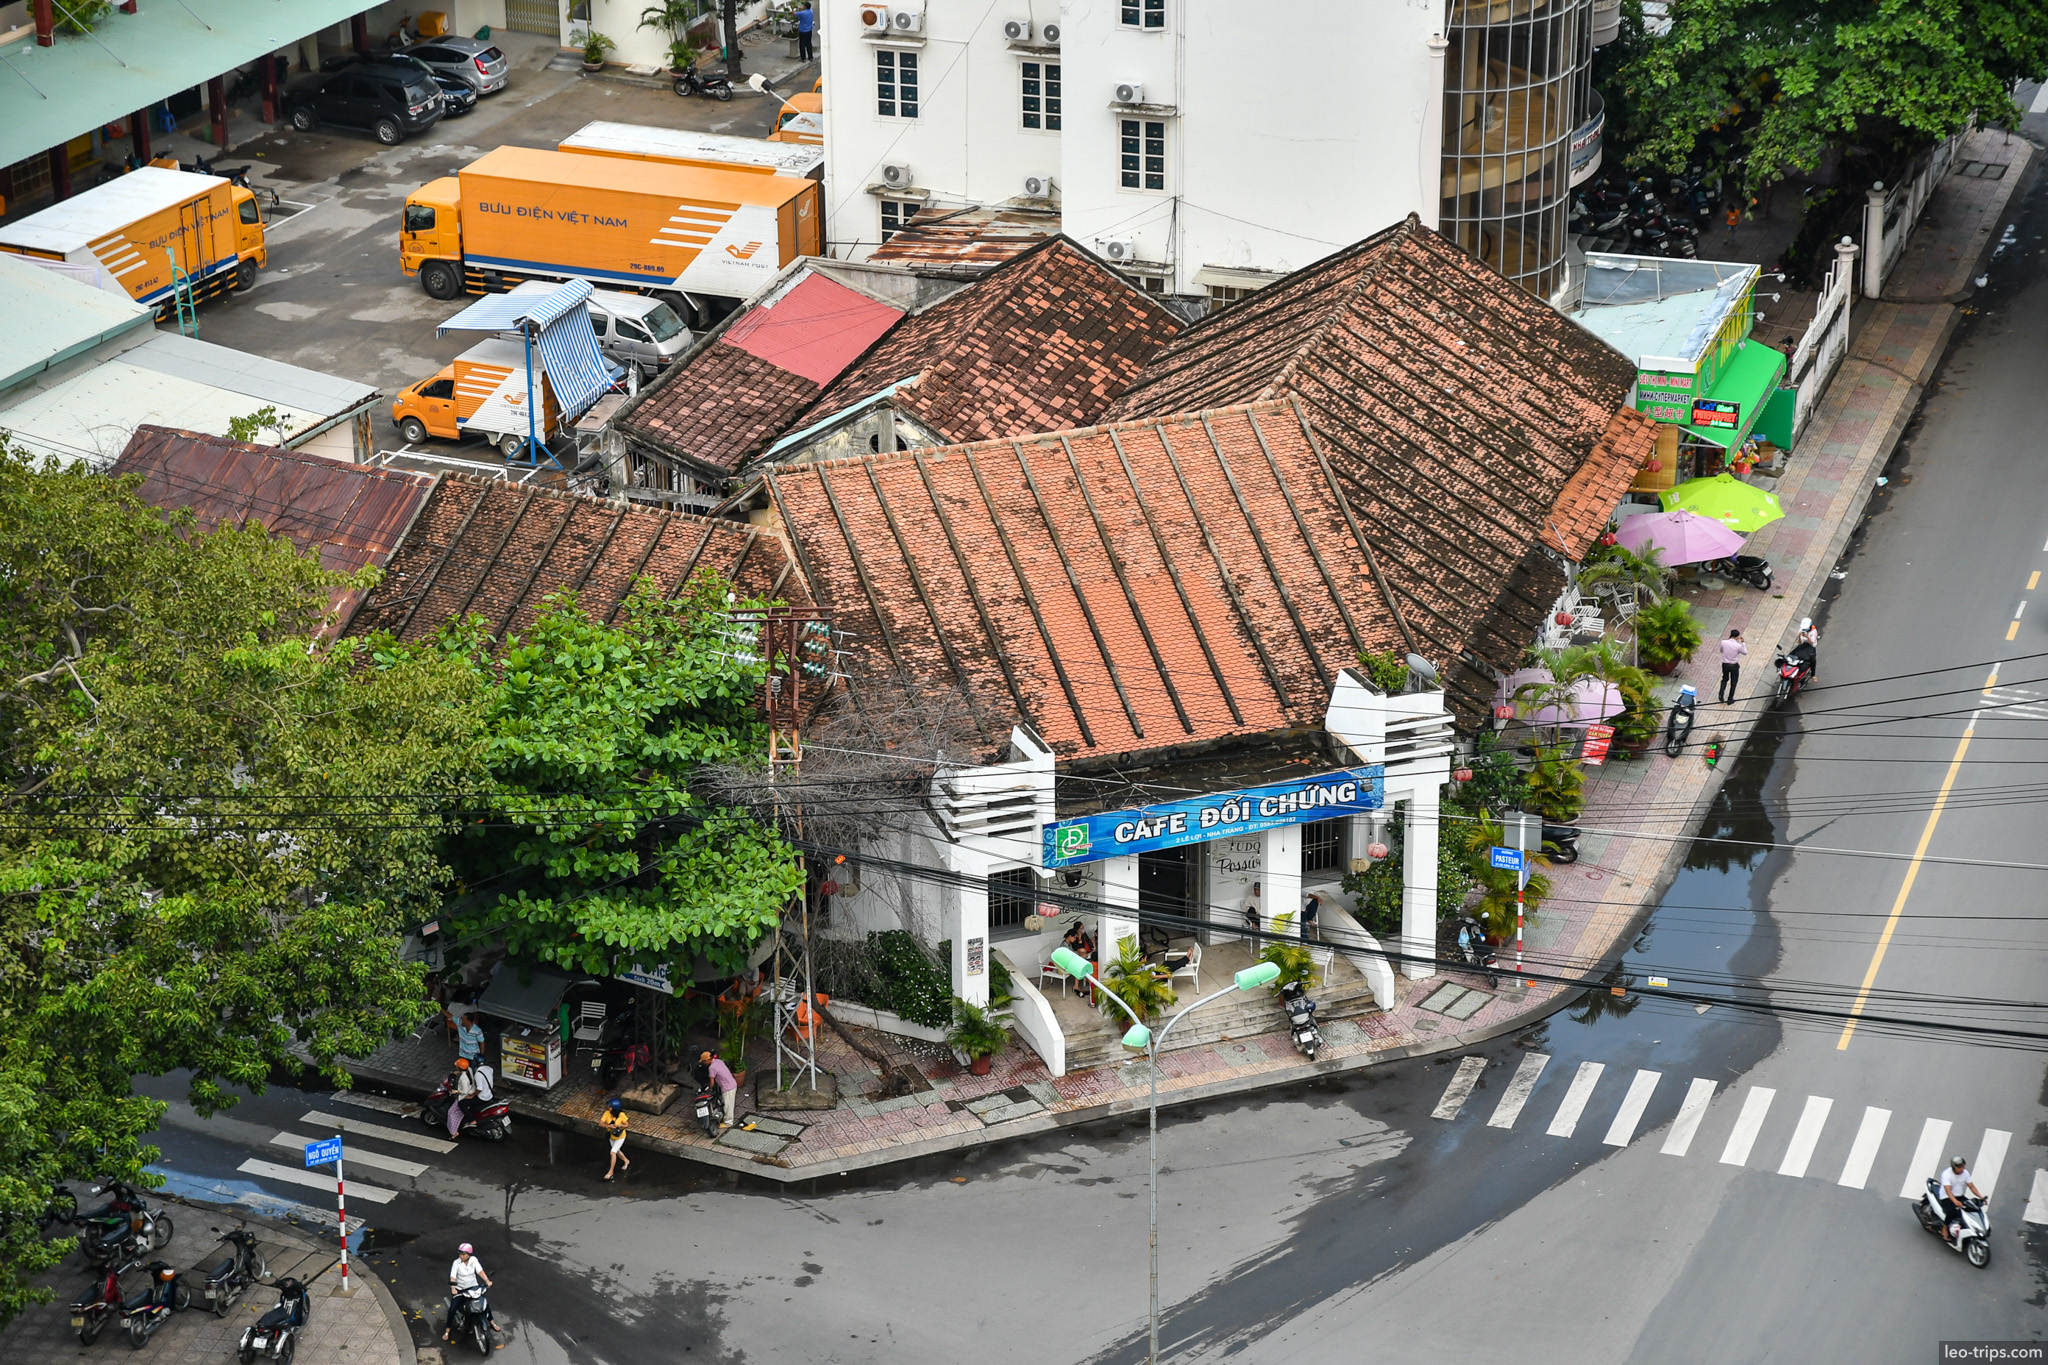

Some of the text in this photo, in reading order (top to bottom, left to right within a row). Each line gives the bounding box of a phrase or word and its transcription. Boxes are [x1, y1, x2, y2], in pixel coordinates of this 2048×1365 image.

[480, 202, 628, 228] BƯU ĐIỆN VIỆT NAM
[149, 234, 168, 249] BƯU
[211, 207, 229, 221] NAM
[1720, 290, 1749, 369] MART
[1657, 376, 1667, 386] MINI
[1669, 377, 1680, 387] MINI
[1680, 377, 1692, 388] MART
[1639, 390, 1691, 404] МИНИ-СУПЕРМАРКЕТ
[1643, 404, 1685, 420] 小型超市
[1114, 781, 1357, 844] CAFE ĐỐI CHỨNG
[1190, 833, 1202, 841] LỢI
[1222, 827, 1243, 835] TRANG
[1496, 855, 1520, 865] PASTEUR
[646, 978, 661, 987] 20m
[308, 1148, 319, 1160] NGÔ
